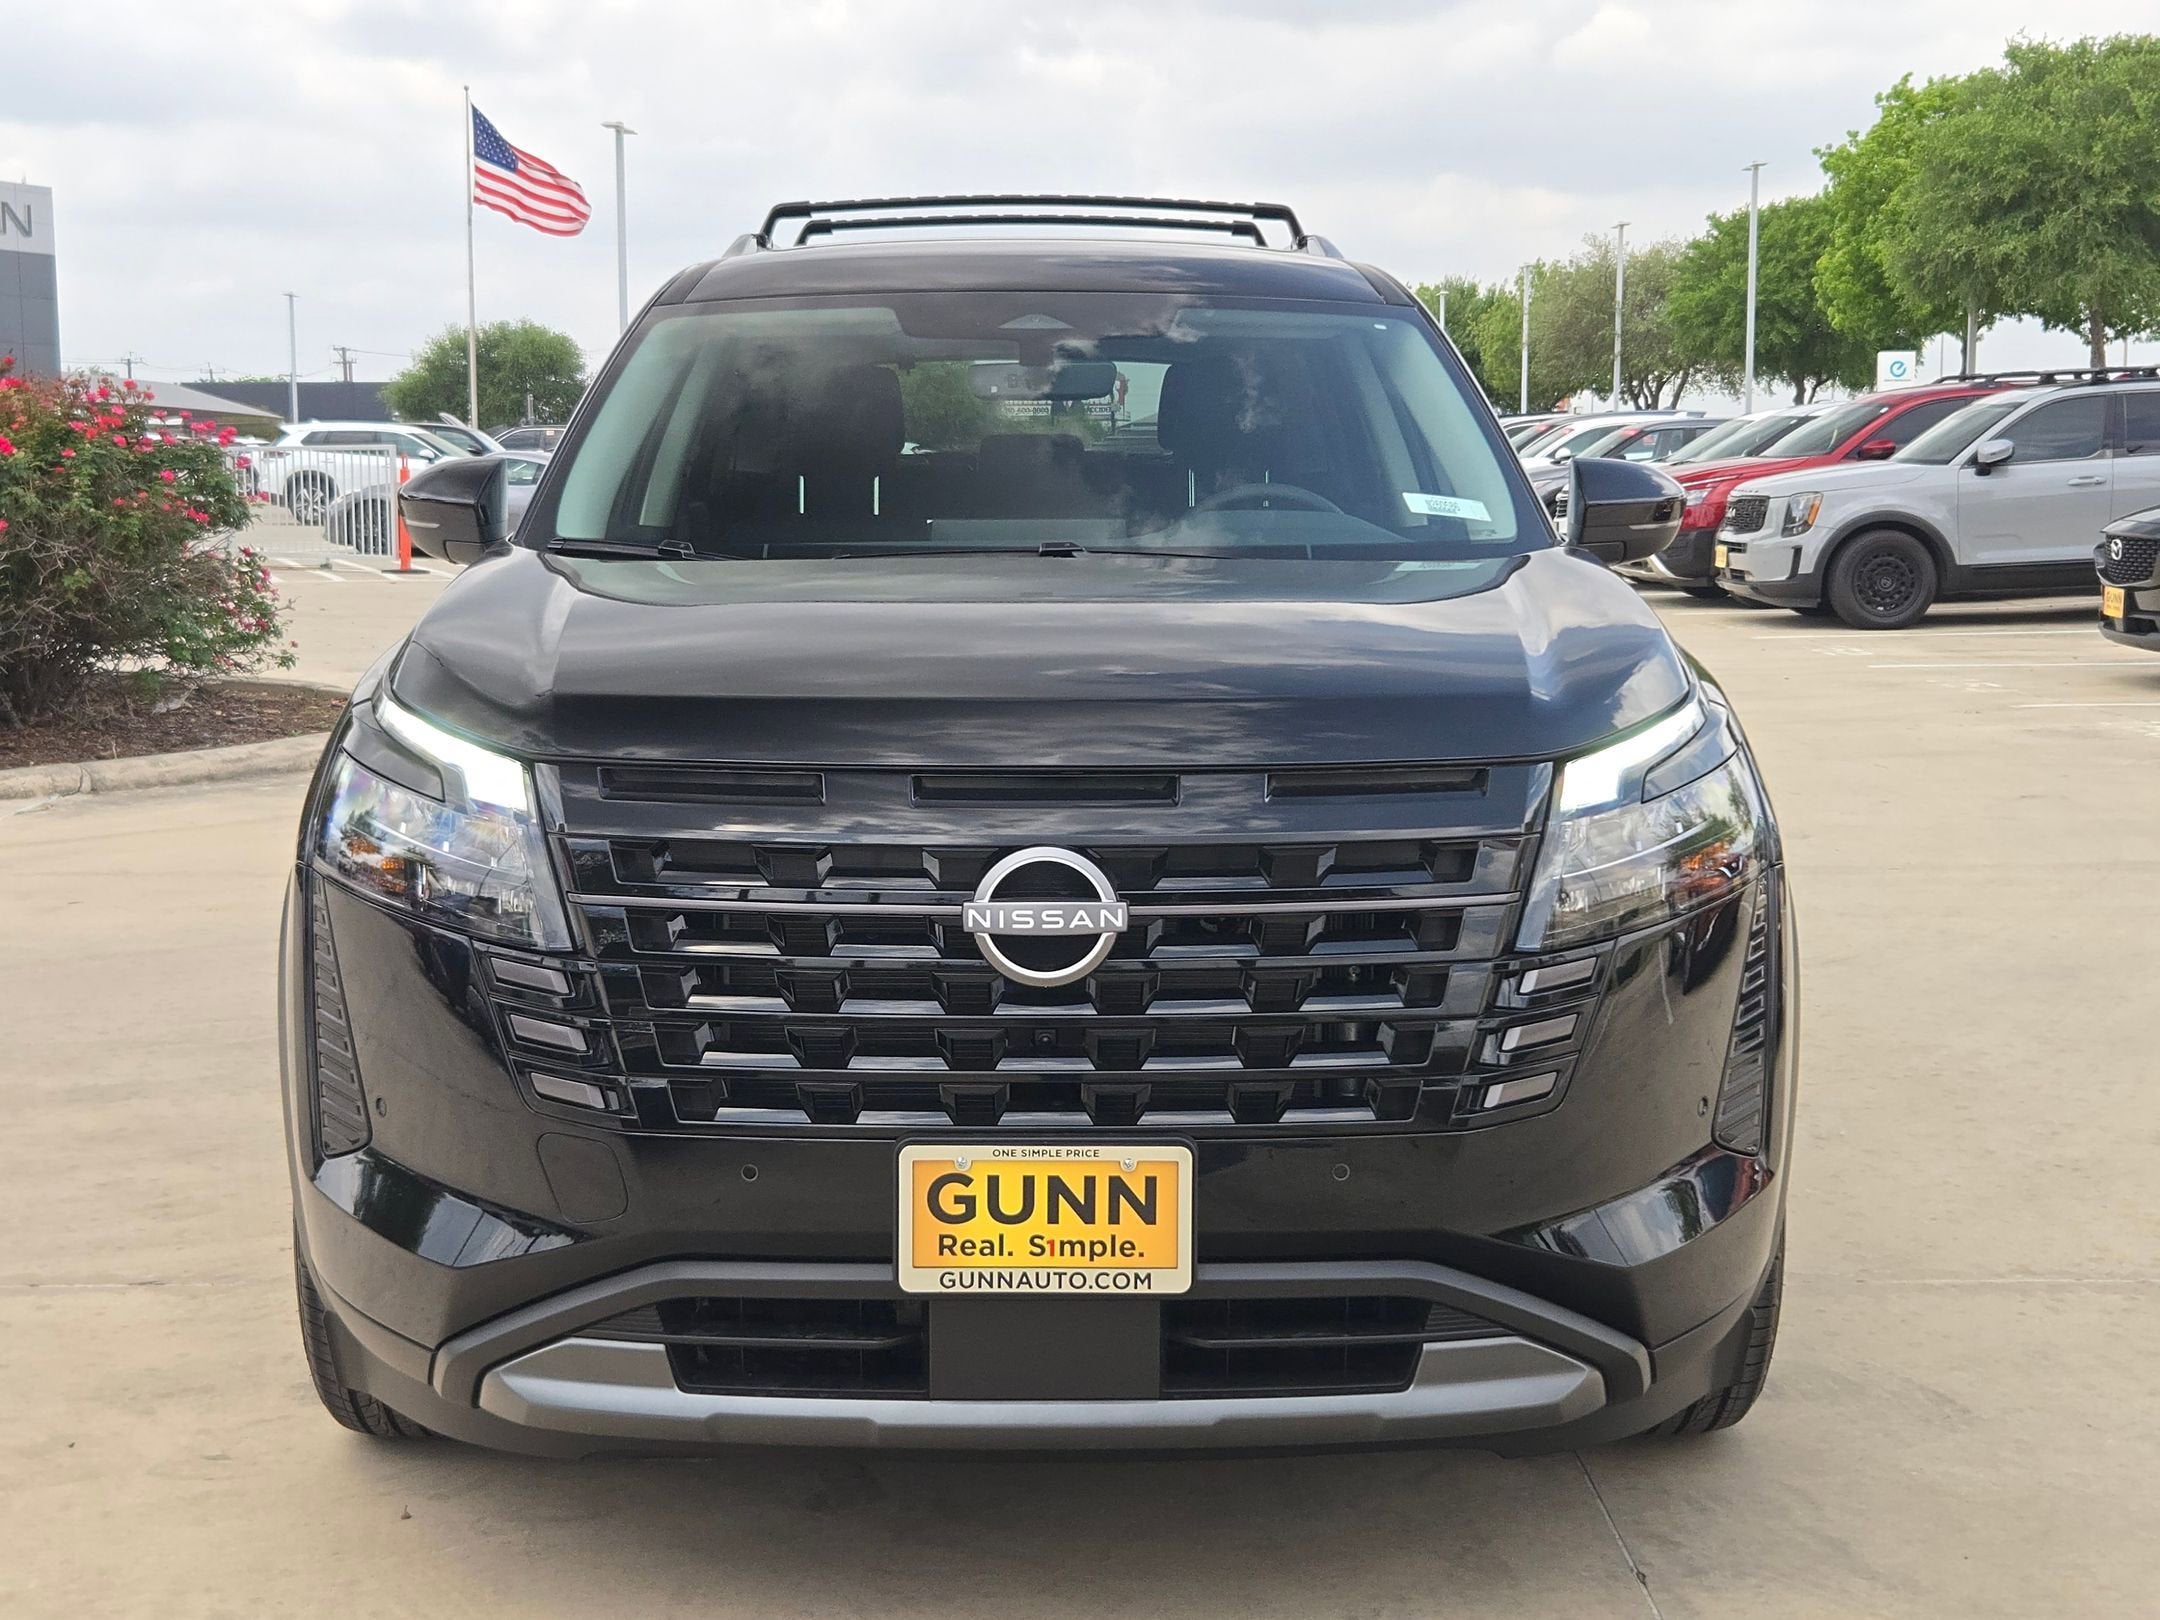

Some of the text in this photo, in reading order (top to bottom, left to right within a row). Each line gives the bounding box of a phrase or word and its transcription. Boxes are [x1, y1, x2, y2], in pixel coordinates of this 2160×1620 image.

[967, 908, 1123, 929] NISSAN
[992, 1149, 1100, 1158] ONE SIMPLE PRICE
[927, 1172, 1158, 1226] GUNN
[938, 1233, 1014, 1257] Real.
[939, 1271, 1152, 1289] GUNNAUTO.COM
